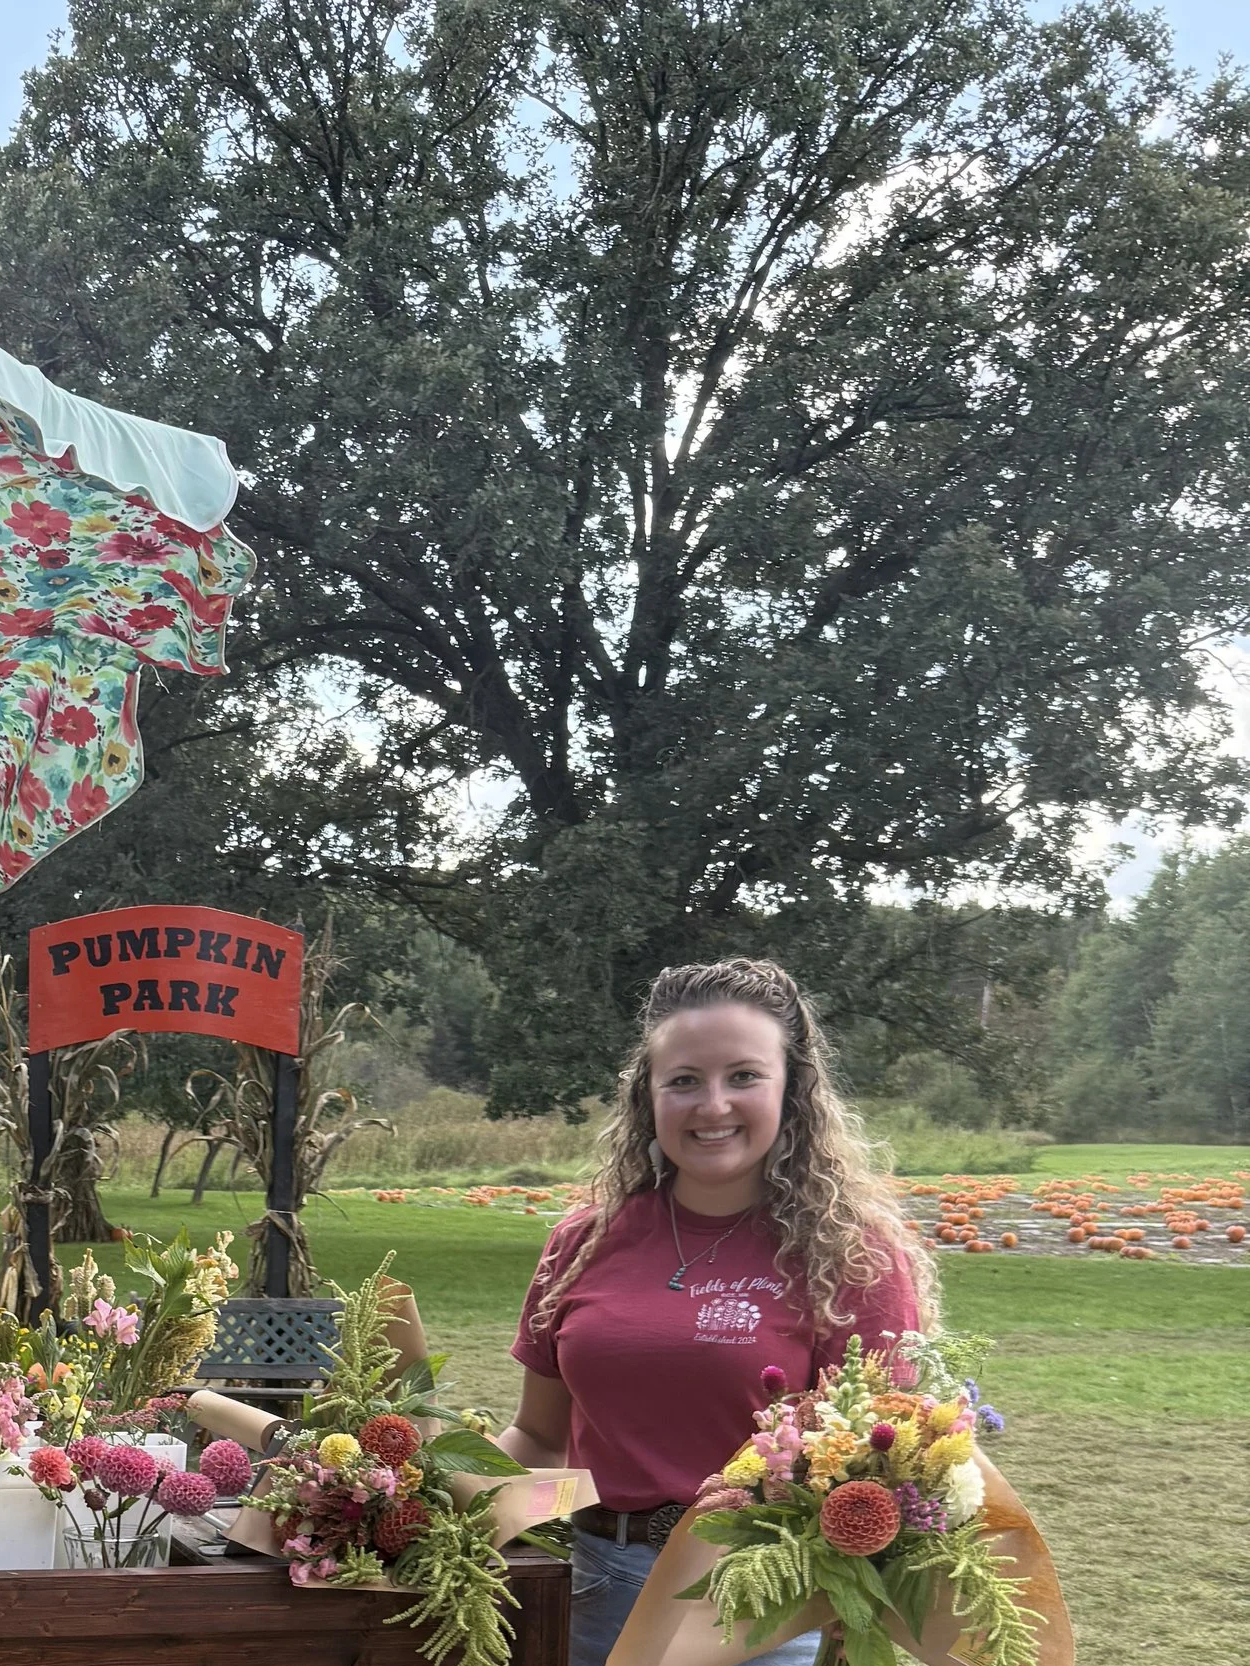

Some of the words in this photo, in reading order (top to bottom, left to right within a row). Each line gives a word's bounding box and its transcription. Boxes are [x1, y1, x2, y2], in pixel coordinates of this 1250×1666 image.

[48, 927, 286, 980] PUMPKIN
[99, 979, 240, 1018] PARK
[690, 1278, 727, 1298] Fields
[730, 1277, 748, 1292] of
[748, 1276, 784, 1300] Plenty
